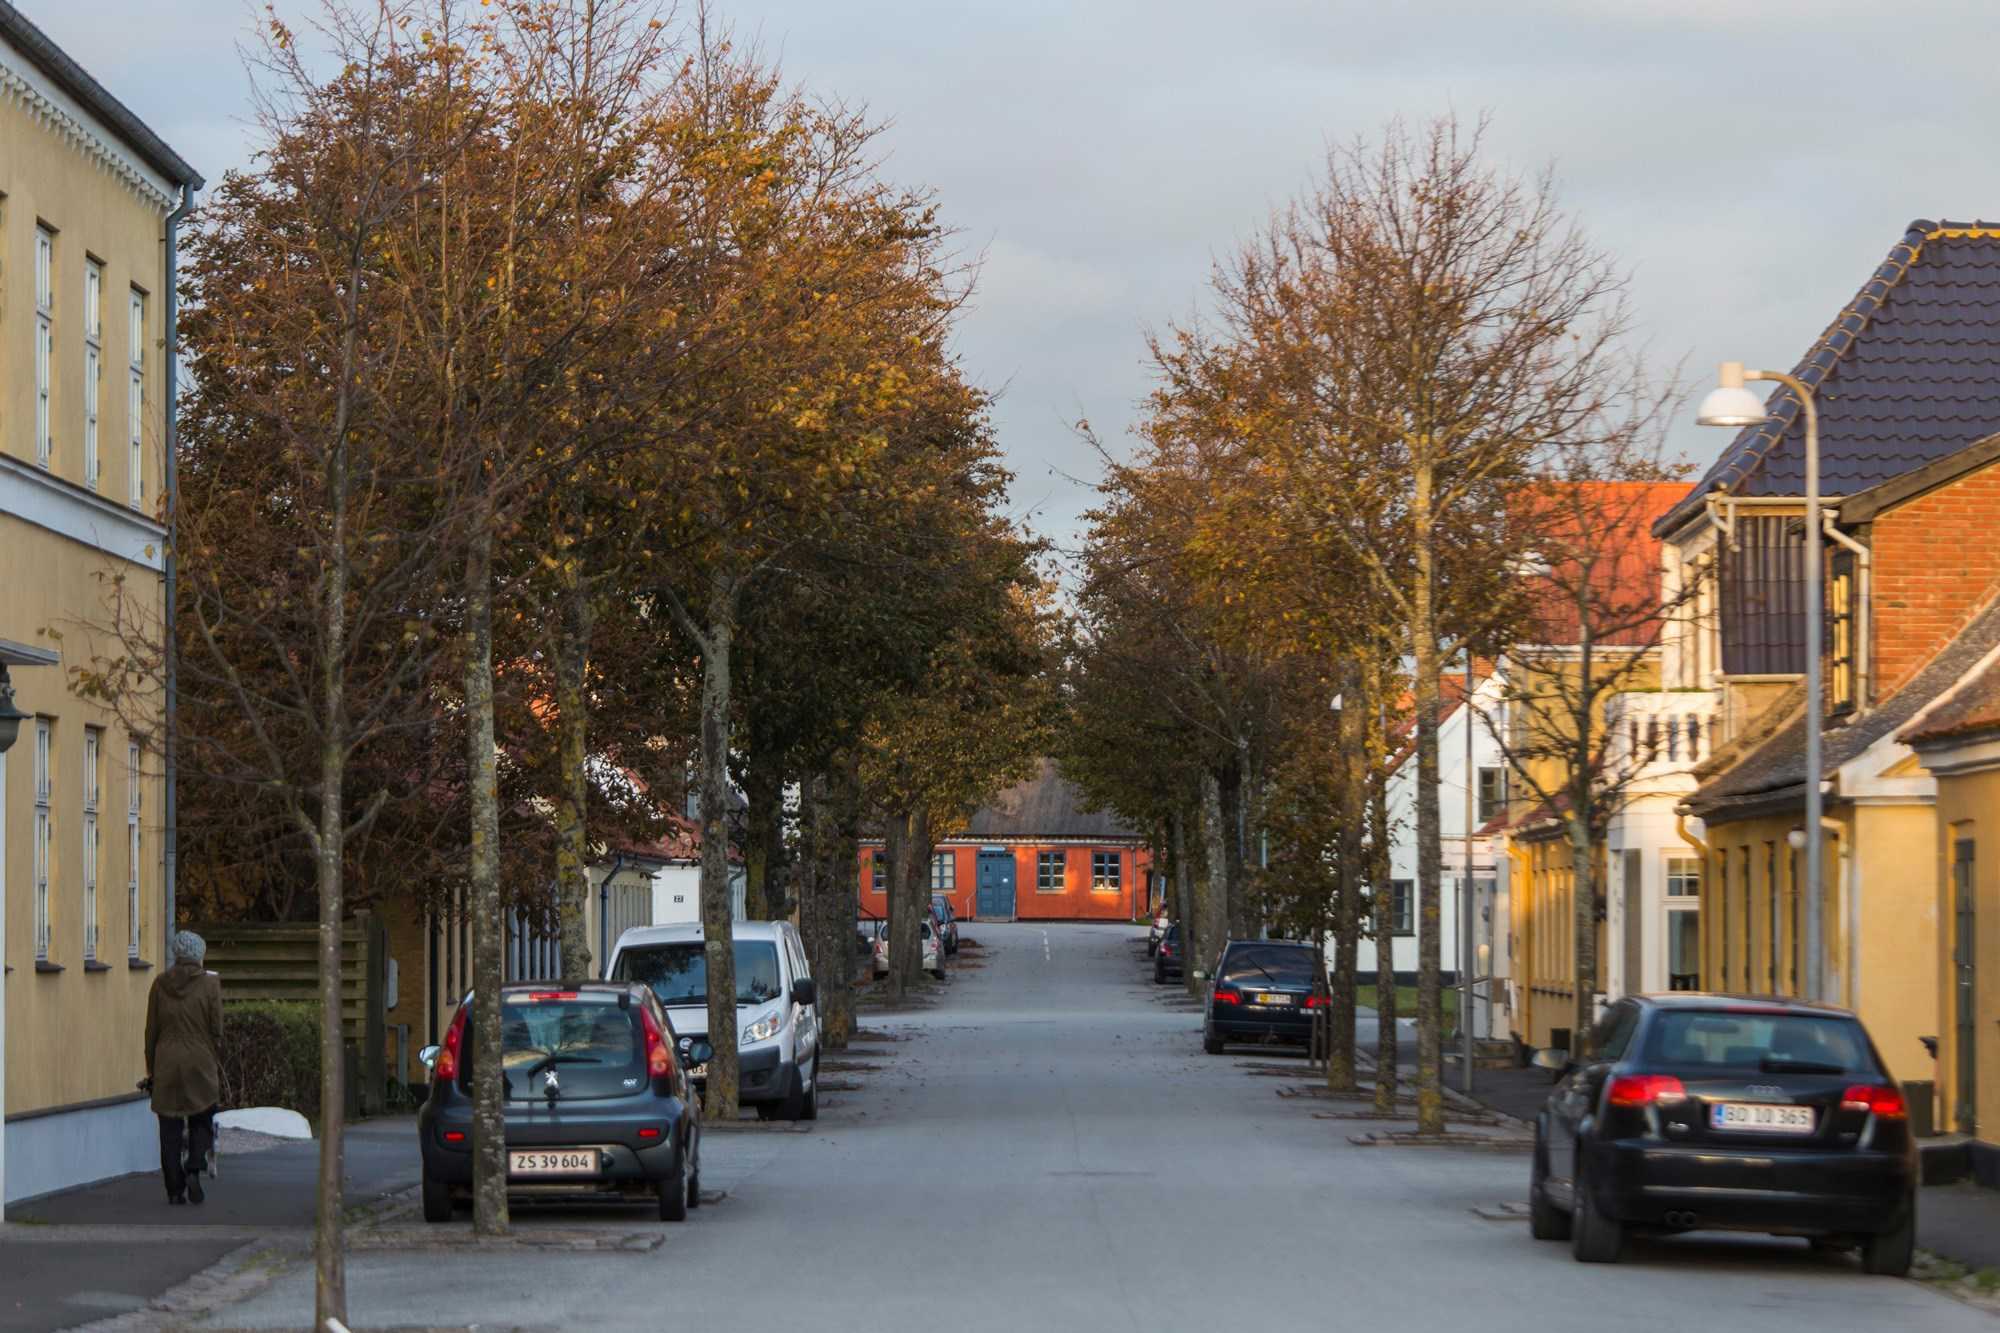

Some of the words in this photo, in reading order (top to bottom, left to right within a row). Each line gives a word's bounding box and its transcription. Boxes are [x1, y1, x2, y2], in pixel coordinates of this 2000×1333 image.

[517, 1155, 537, 1168] ZS
[541, 1155, 558, 1168] 39
[561, 1155, 589, 1168] 604
